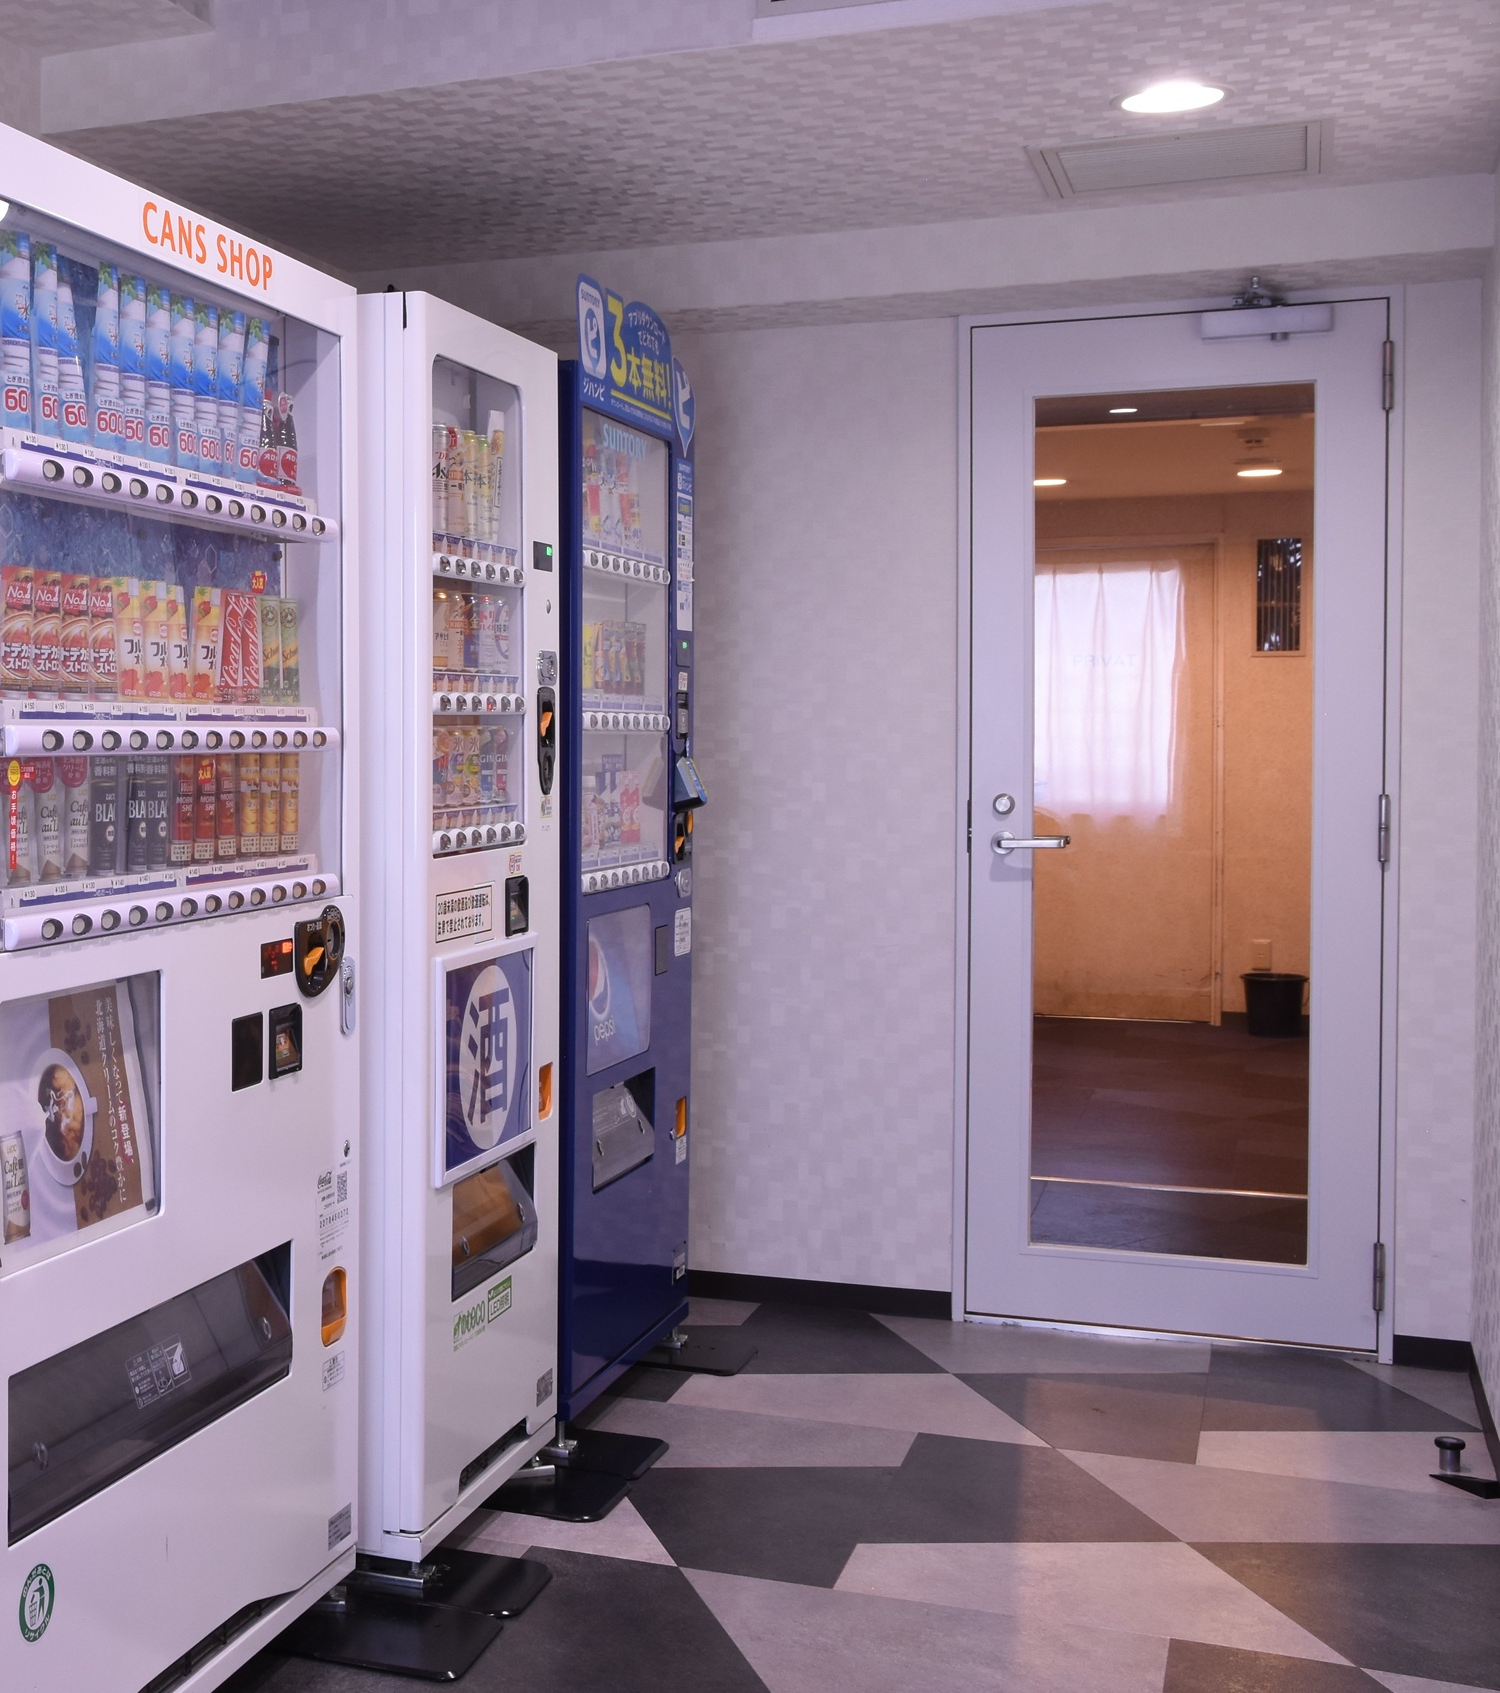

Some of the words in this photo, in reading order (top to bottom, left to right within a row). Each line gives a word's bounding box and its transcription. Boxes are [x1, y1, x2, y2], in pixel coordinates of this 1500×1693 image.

[142, 201, 206, 264] CANS
[217, 234, 273, 290] SHOP
[4, 388, 30, 413] 60
[7, 582, 31, 599] No.1
[36, 585, 59, 602] No.1
[64, 589, 88, 605] No.1
[91, 593, 112, 608] No.1
[594, 1015, 616, 1046] pepsi
[468, 987, 510, 1126] 酒
[25, 1615, 50, 1641] リサイクル
